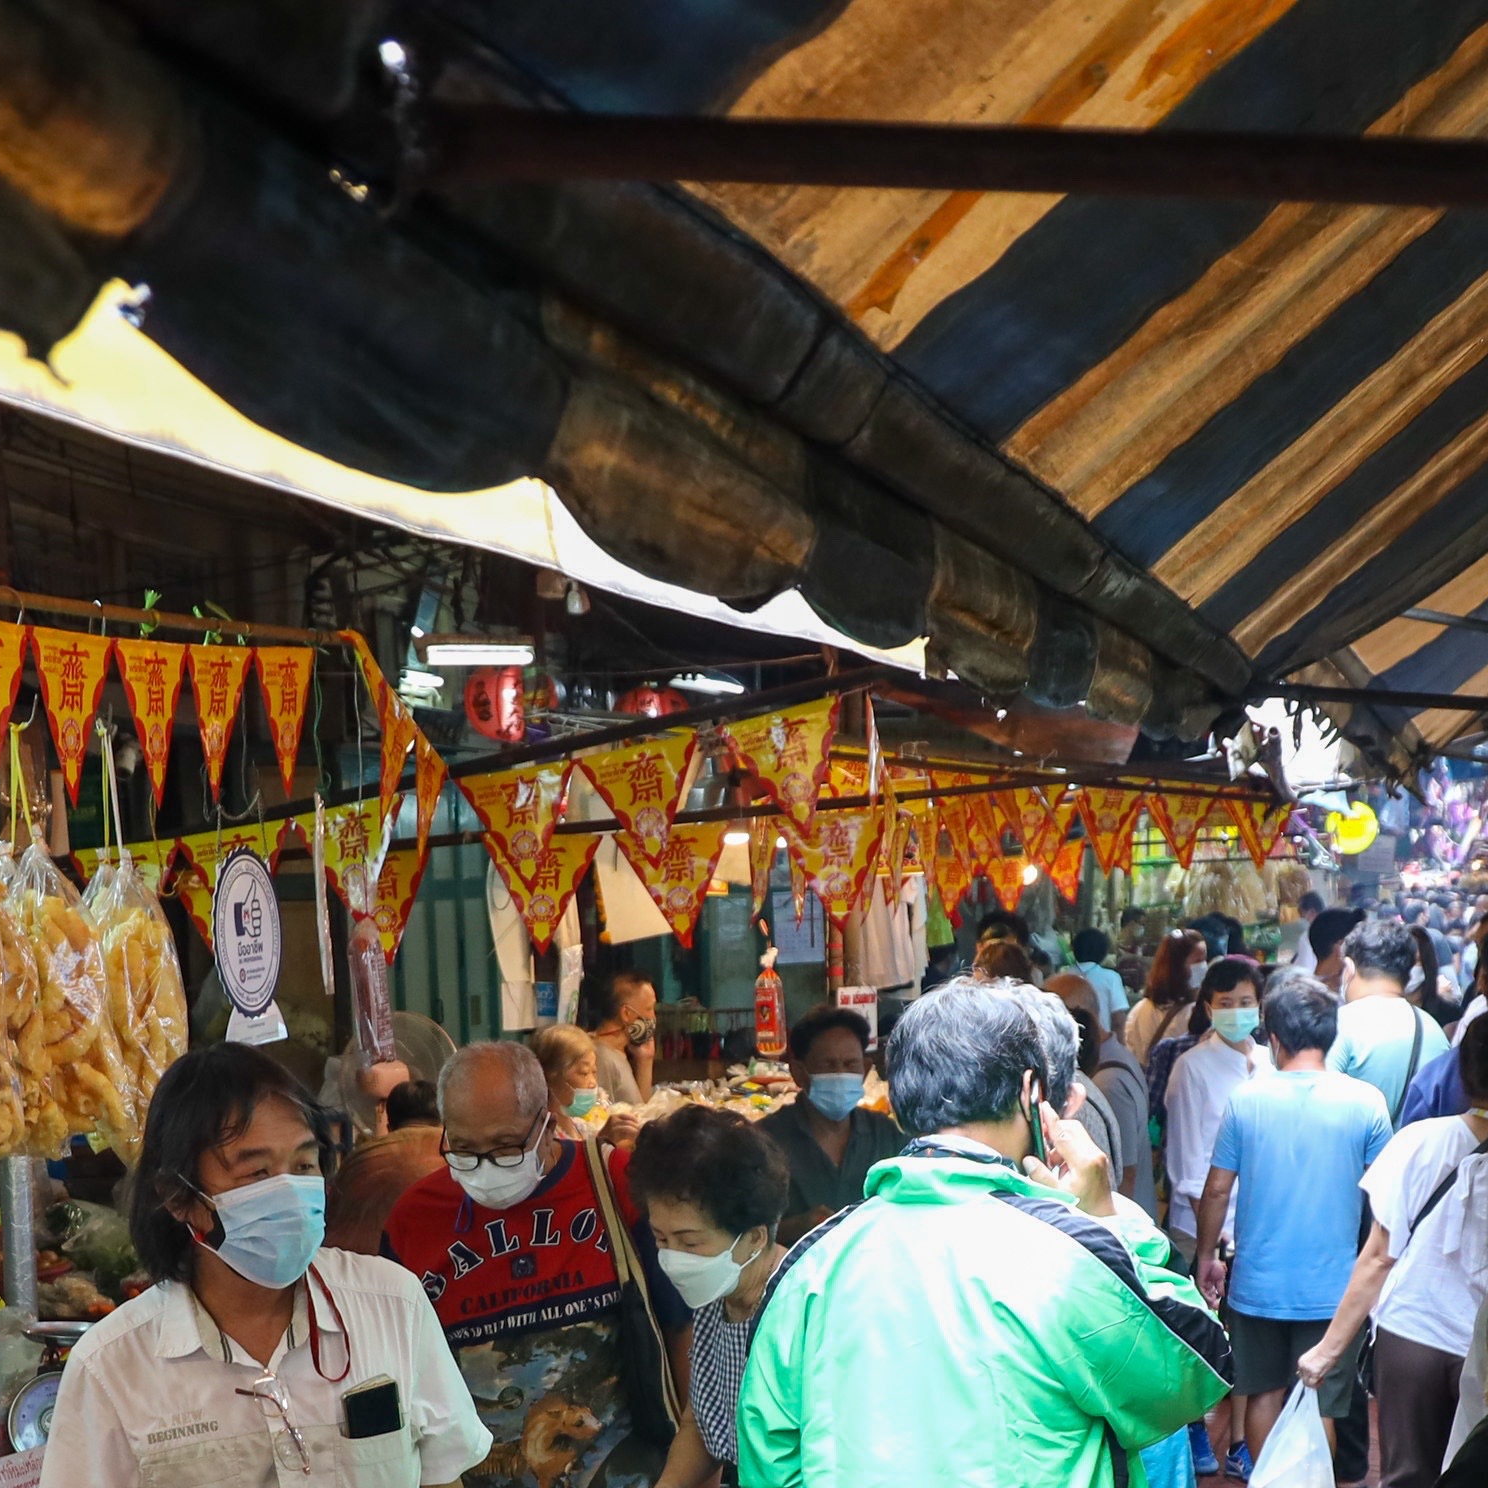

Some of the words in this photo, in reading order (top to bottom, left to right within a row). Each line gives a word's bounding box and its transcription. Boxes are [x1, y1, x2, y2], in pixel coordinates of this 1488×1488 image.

[421, 1207, 610, 1301] GALLO
[461, 1270, 585, 1315] CALIFORNIA
[506, 1311, 537, 1329] WITH
[539, 1306, 563, 1322] ALL
[171, 1410, 204, 1425] NEW
[147, 1420, 219, 1445] BEGINNING
